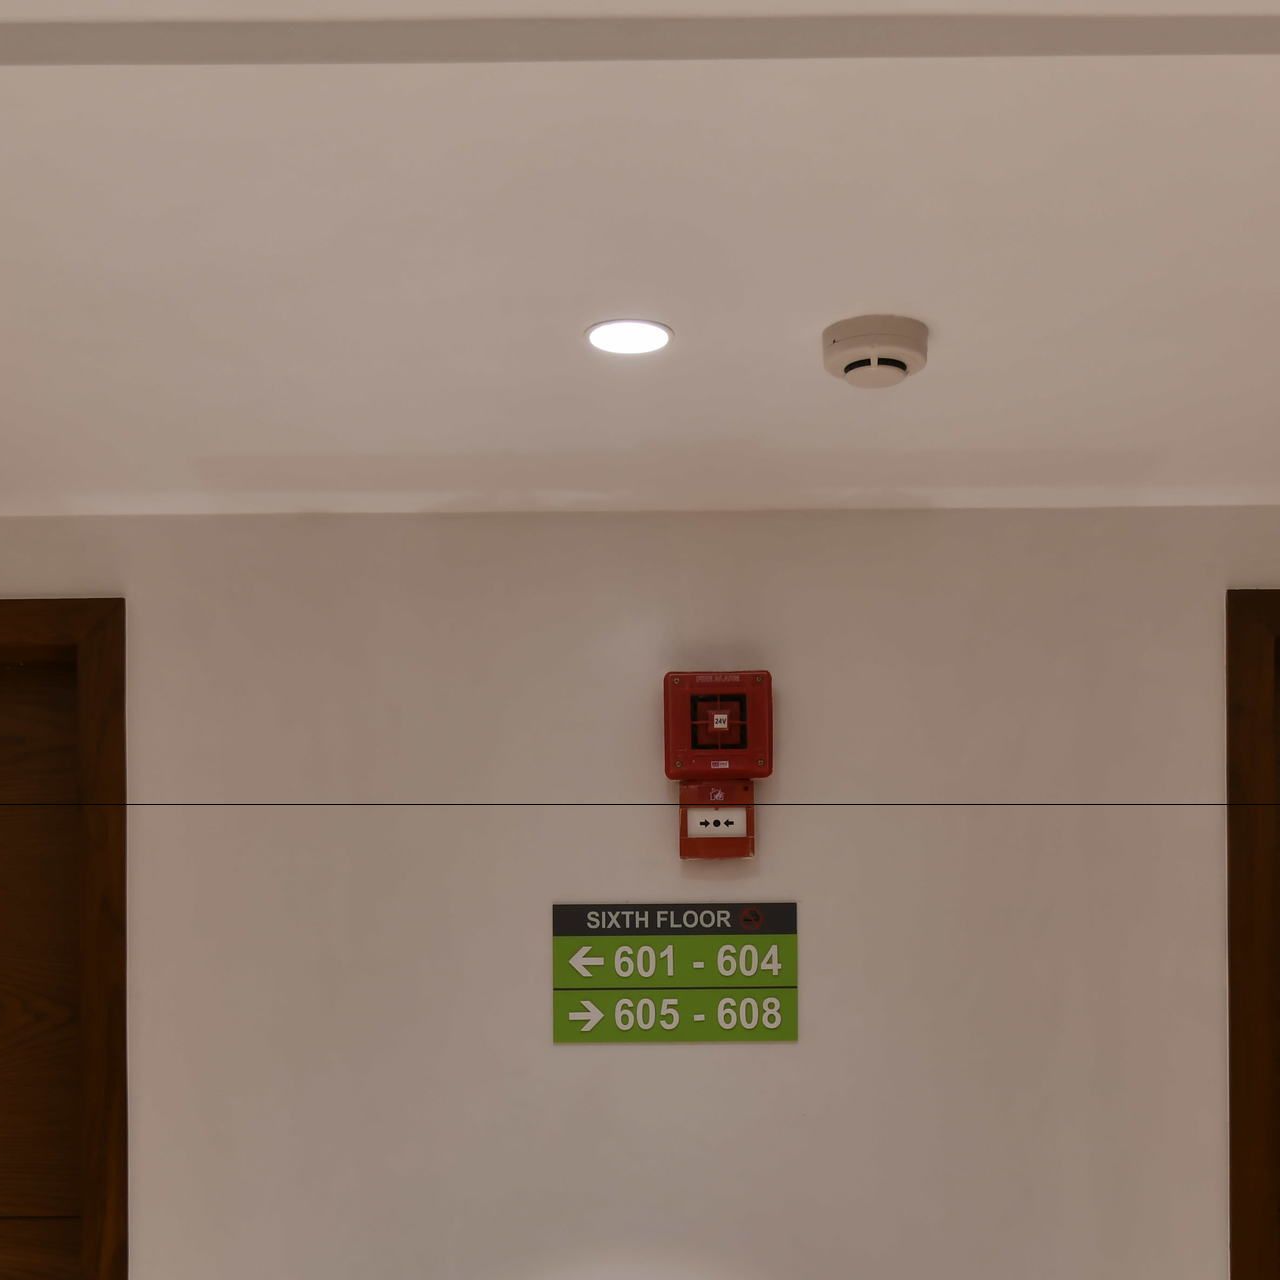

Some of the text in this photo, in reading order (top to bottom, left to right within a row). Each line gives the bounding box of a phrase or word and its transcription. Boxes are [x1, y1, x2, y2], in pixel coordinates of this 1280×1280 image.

[586, 910, 732, 929] SIXTH FLOOR
[614, 945, 674, 978] 601
[717, 944, 782, 976] 604
[614, 998, 680, 1030] 605
[717, 997, 782, 1030] 608
